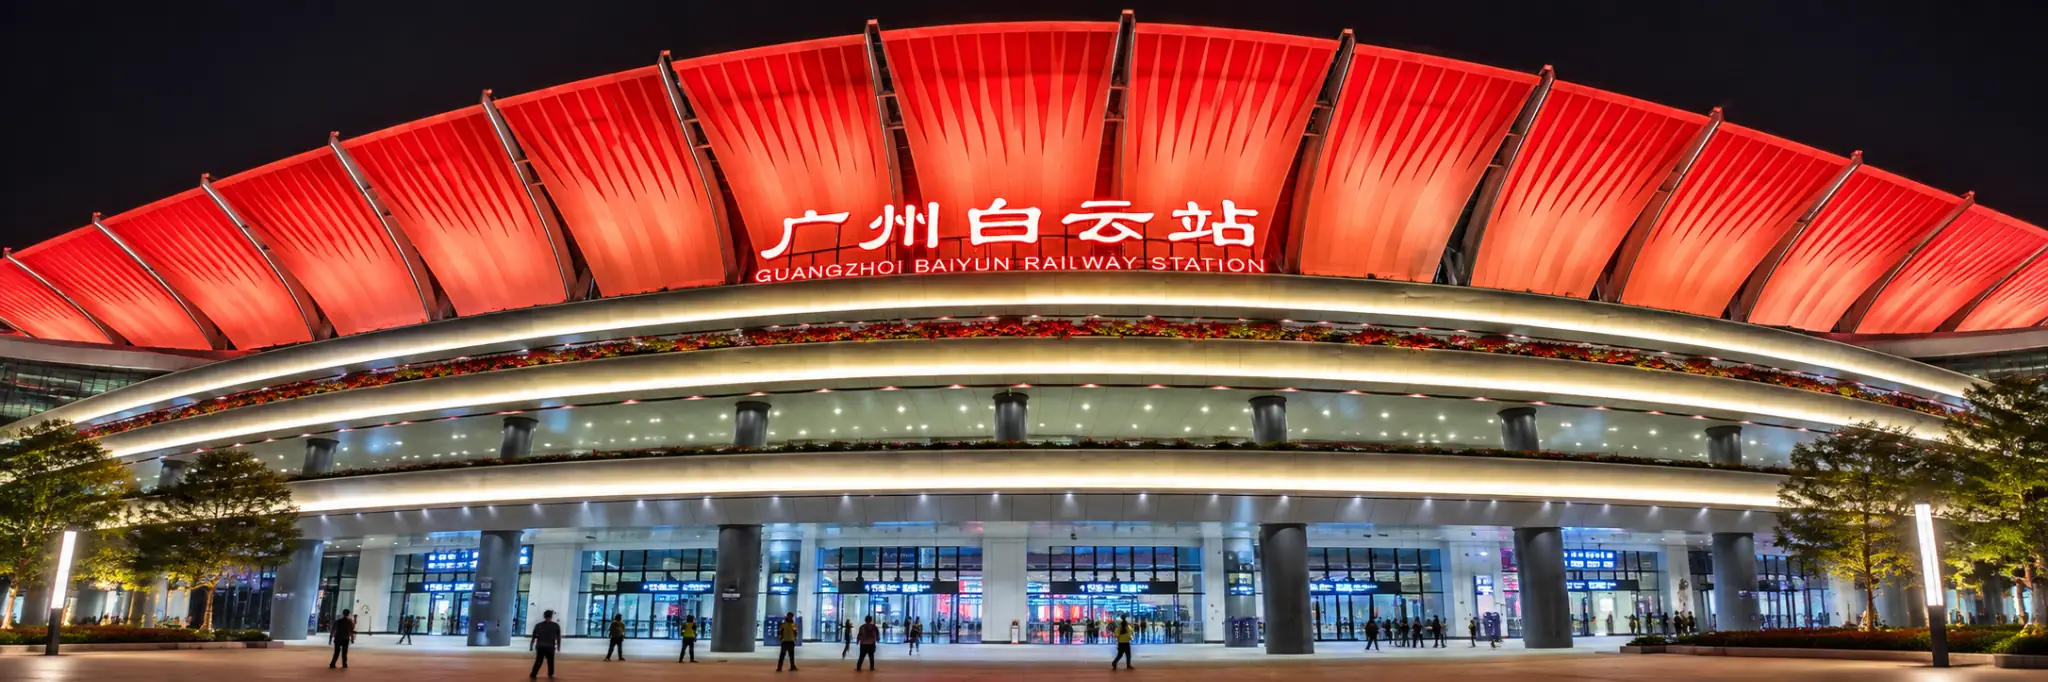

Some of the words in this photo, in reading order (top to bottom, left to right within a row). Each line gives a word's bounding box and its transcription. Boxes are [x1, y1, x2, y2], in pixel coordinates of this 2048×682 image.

[760, 198, 1260, 259] 广州白云站
[915, 257, 1010, 273] BAIYUN
[1024, 256, 1138, 271] RAILWAY
[1151, 256, 1266, 273] STATION
